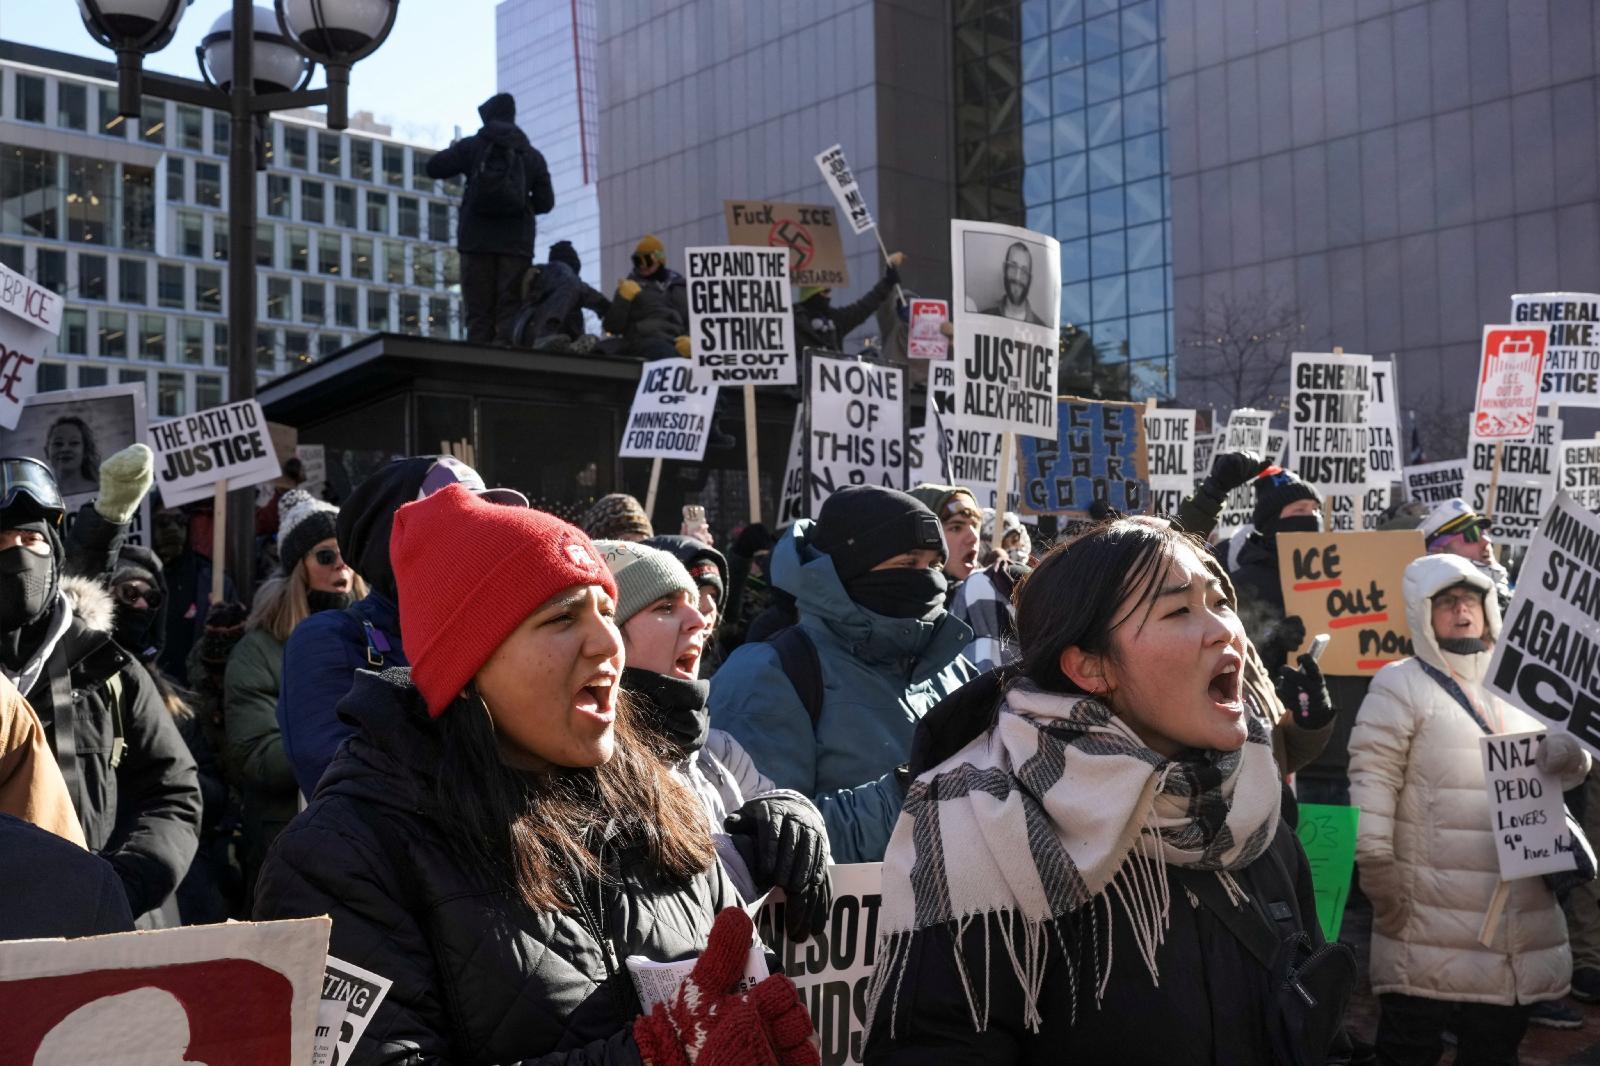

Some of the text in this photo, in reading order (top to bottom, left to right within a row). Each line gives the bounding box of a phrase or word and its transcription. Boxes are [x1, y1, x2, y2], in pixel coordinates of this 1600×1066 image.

[732, 205, 833, 226] Fuck ICE
[690, 252, 786, 277] EXPAND THE
[691, 280, 788, 314] GENERAL
[1515, 302, 1600, 322] GENERAL
[700, 317, 784, 351] STRIKE!
[699, 353, 788, 366] ICE OUT
[965, 334, 1053, 392] JUSTICE
[1583, 351, 1600, 370] TO
[643, 366, 708, 395] ICE OU
[712, 368, 779, 381] NOW!
[820, 363, 898, 400] NONE
[659, 395, 687, 404] OF
[964, 382, 1005, 419] ALEX
[1007, 391, 1053, 428] PRETTI
[150, 403, 259, 451] THE PATH TO
[631, 412, 705, 433] MINNESOTA
[846, 400, 880, 432] OF
[1164, 418, 1189, 440] THE
[626, 431, 703, 452] FOR GOOD!
[813, 430, 875, 466] THIS
[882, 438, 903, 468] IS
[958, 429, 991, 456] NOT
[993, 433, 1002, 457] A
[1294, 427, 1321, 452] THE
[1324, 427, 1351, 453] PATH
[162, 431, 267, 482] JUSTICE
[941, 455, 998, 482] RIME!
[1294, 456, 1366, 483] JUSTICE
[1408, 467, 1465, 487] GENERAL
[1473, 483, 1543, 516] SRIKE!
[1293, 544, 1343, 580] ICE
[1493, 644, 1600, 751] ICE
[1495, 778, 1542, 804] PEDO
[324, 973, 370, 1009] TING
